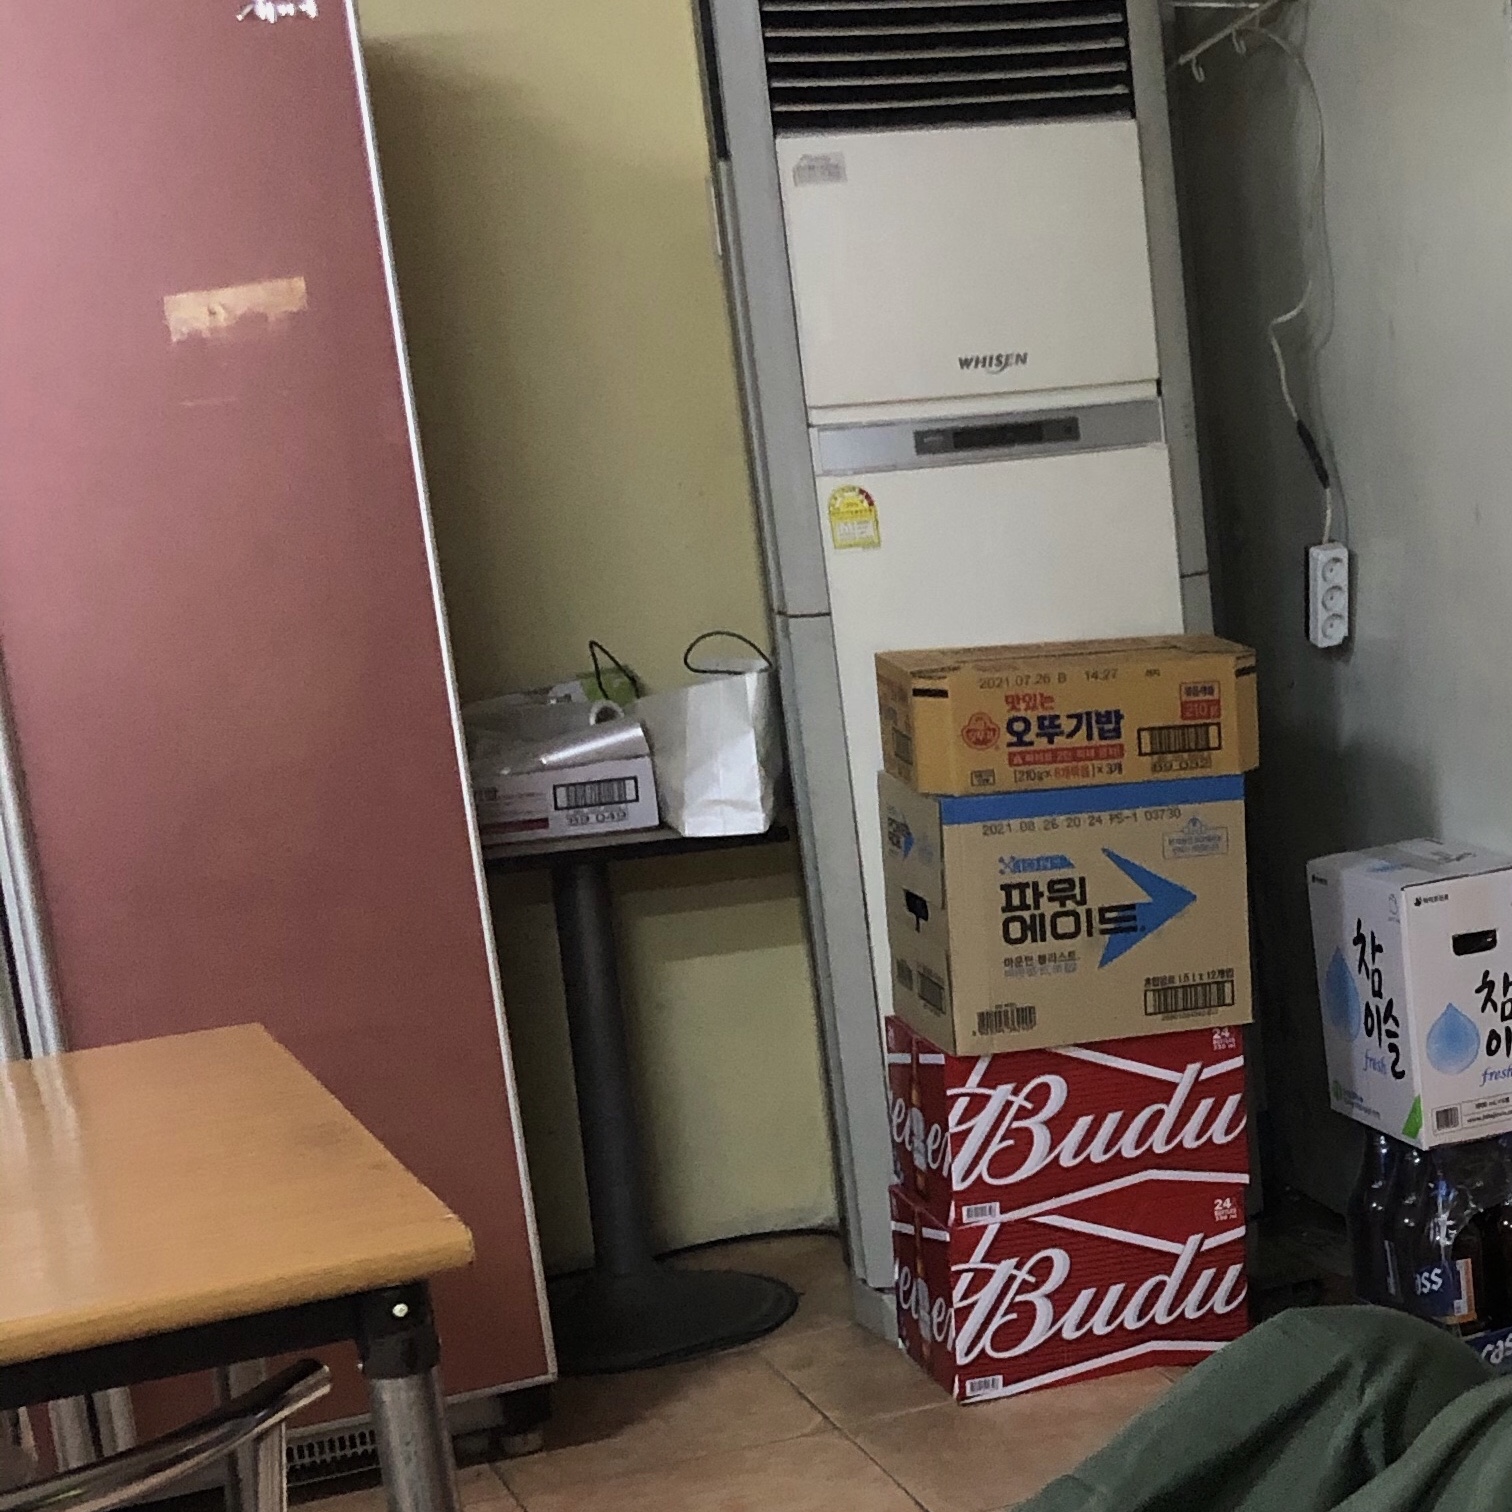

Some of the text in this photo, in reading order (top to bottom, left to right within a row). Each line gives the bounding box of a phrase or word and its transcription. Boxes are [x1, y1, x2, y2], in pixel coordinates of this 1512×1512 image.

[958, 352, 1028, 373] WHISEN
[1004, 691, 1055, 713] 맛있는
[1005, 708, 1125, 748] 오뚜기밥
[1000, 876, 1087, 913] 파워
[1002, 903, 1138, 945] 에이드
[1212, 1027, 1230, 1039] 24
[1214, 1197, 1232, 1210] 24
